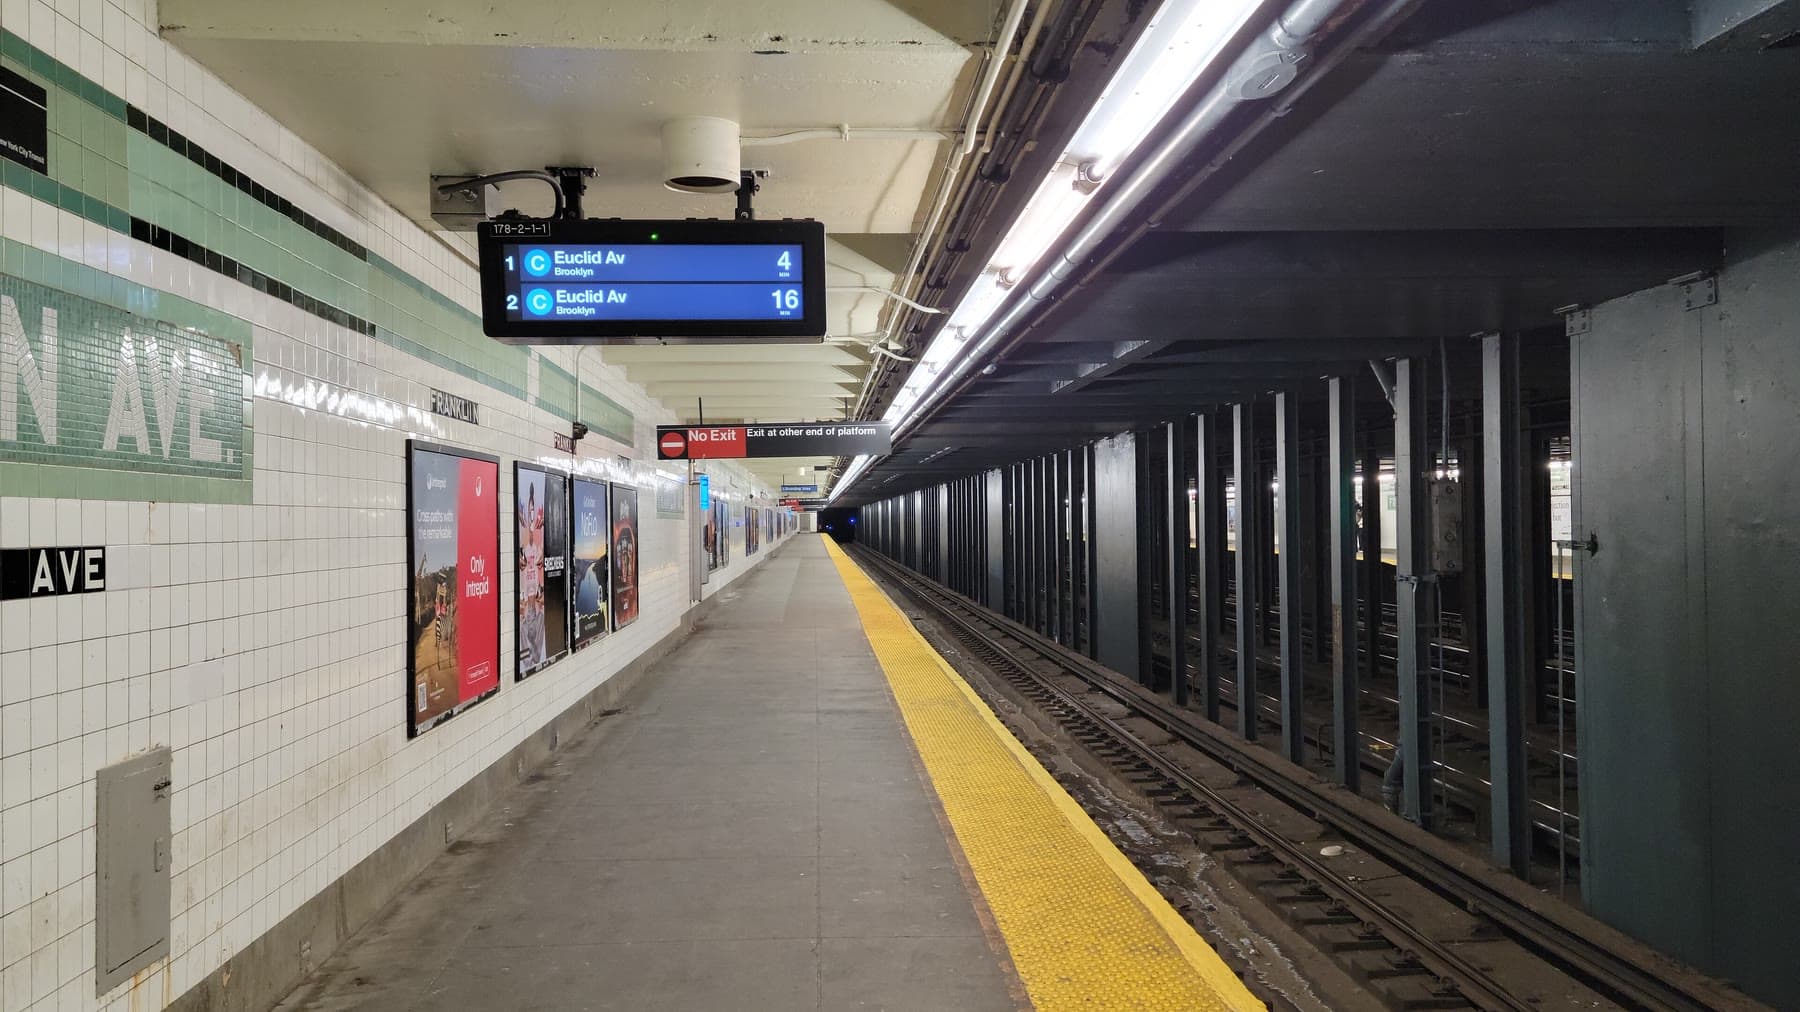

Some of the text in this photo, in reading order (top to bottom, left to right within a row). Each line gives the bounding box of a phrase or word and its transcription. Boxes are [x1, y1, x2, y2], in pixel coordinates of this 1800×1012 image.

[493, 223, 547, 234] 178-2-1-1
[505, 250, 792, 270] 1 C Euclid Av 4
[554, 267, 594, 278] Brooklyn
[506, 289, 799, 310] 2 C Euclid Av 16
[556, 306, 596, 317] Brooklyn
[102, 328, 234, 464] AVE.
[431, 389, 479, 424] FRANKLIN
[688, 427, 876, 441] No Exit Exit at other end of platform
[32, 549, 104, 593] AVE
[470, 555, 485, 576] Only
[465, 576, 489, 599] Intrepid
